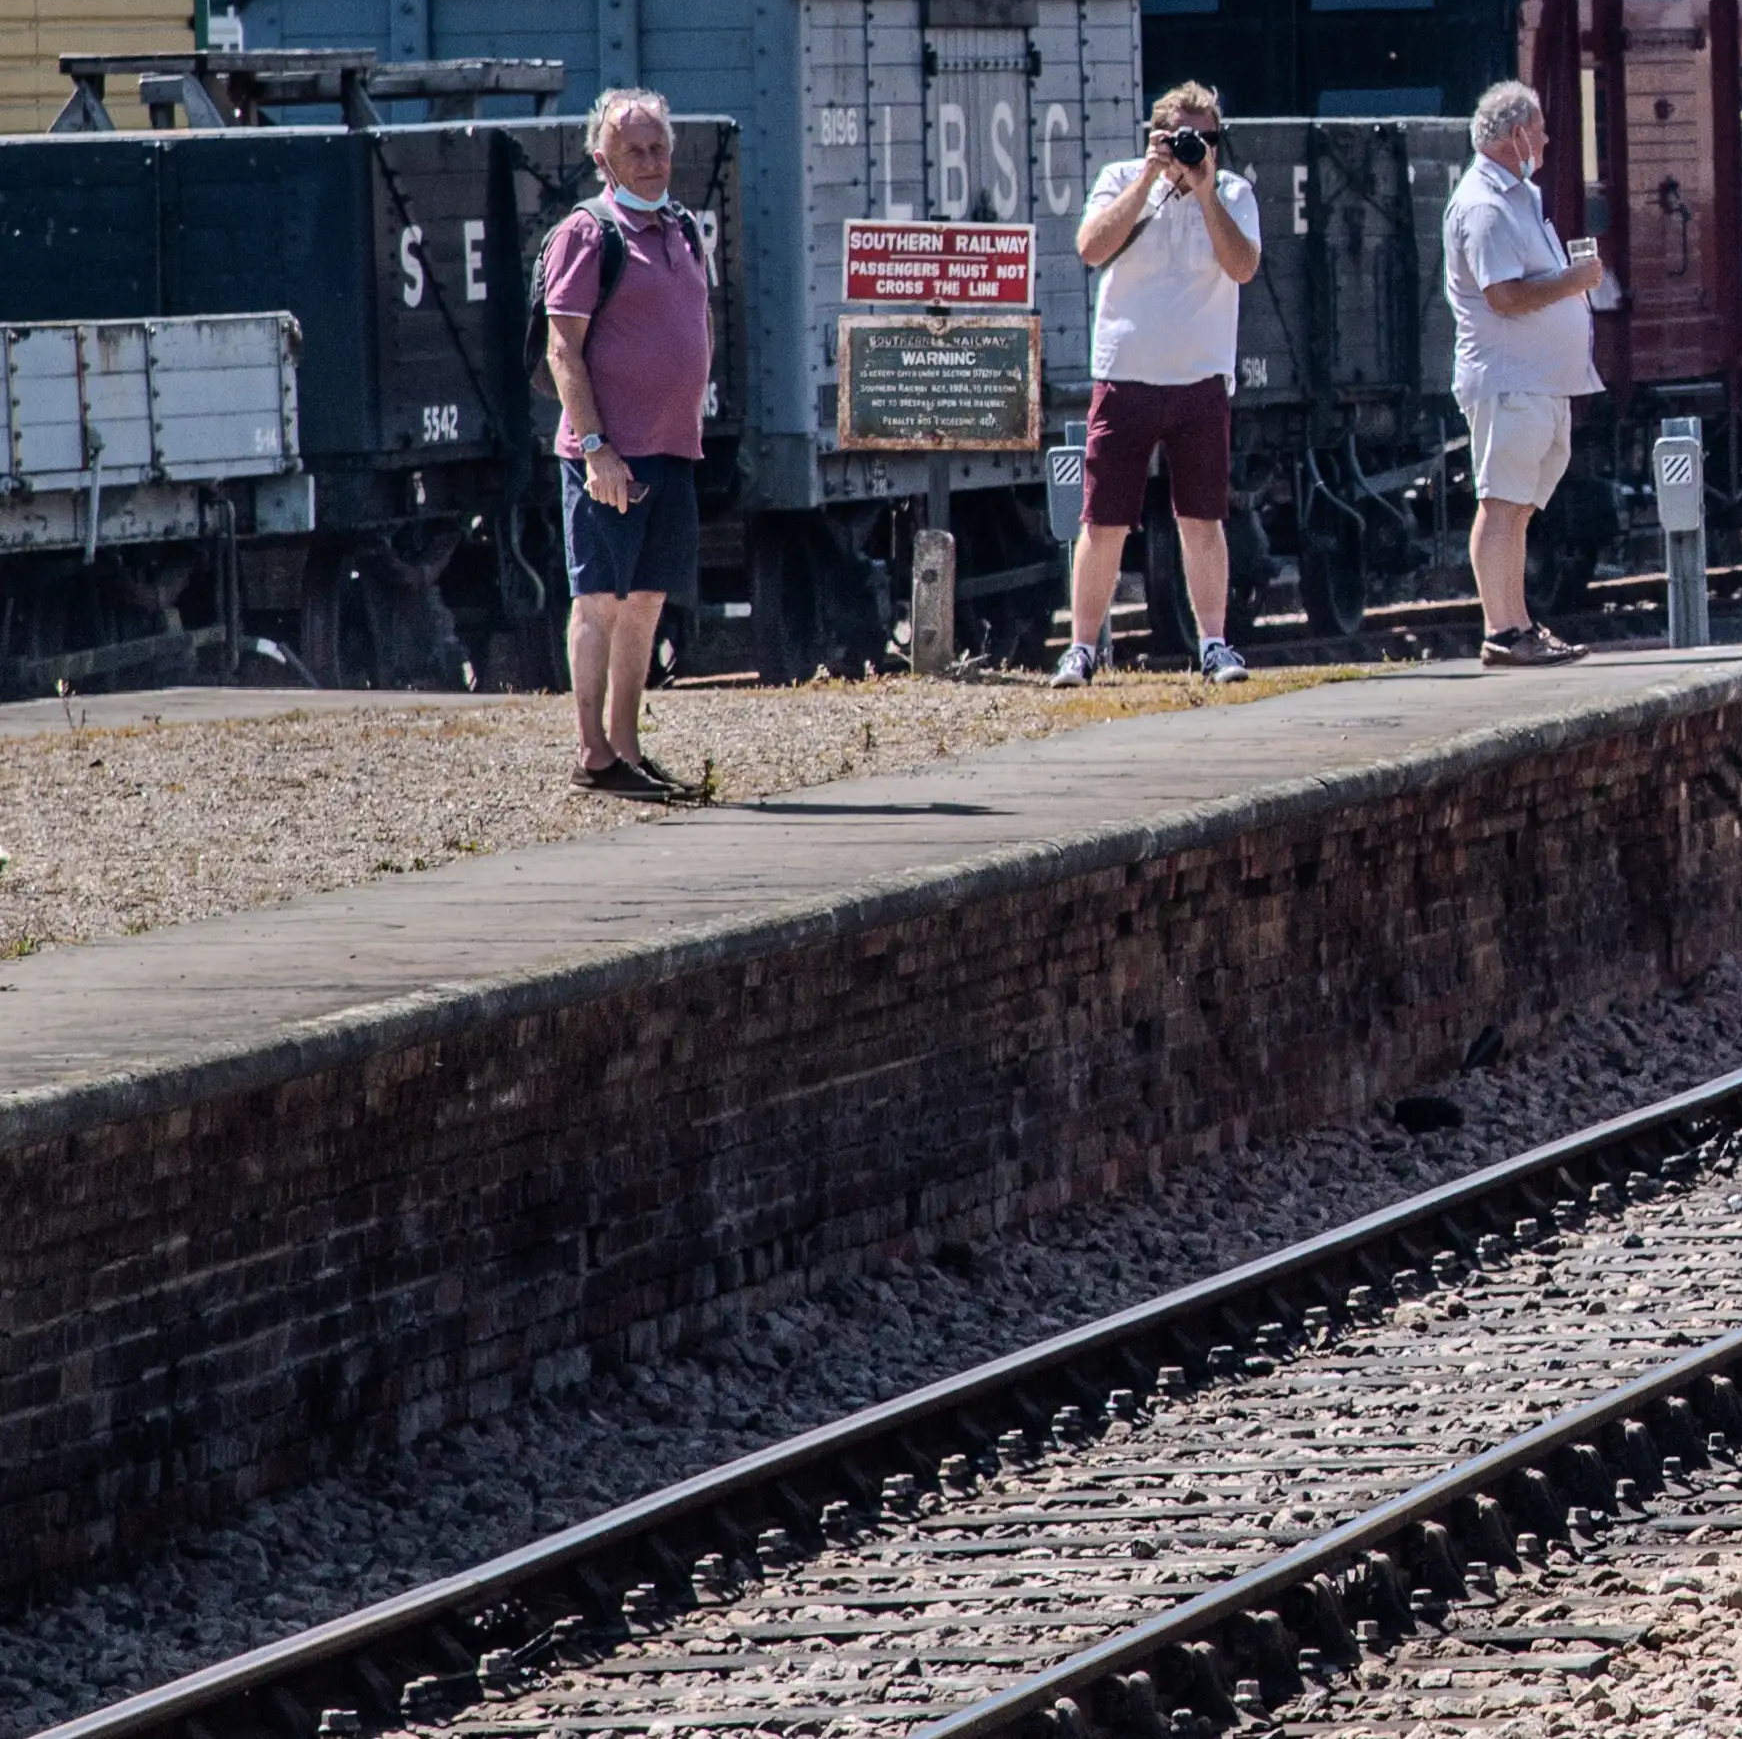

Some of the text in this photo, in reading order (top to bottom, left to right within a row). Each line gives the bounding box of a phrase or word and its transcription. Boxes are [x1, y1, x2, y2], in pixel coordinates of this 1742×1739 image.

[820, 107, 858, 146] 8196
[850, 232, 1029, 254] SOUTHERN RAILWAY
[850, 261, 1027, 279] PASSENGERS MUST NOT
[875, 279, 1000, 297] CROSS THE LINE
[901, 351, 977, 366] WARNING
[422, 405, 458, 443] 5542
